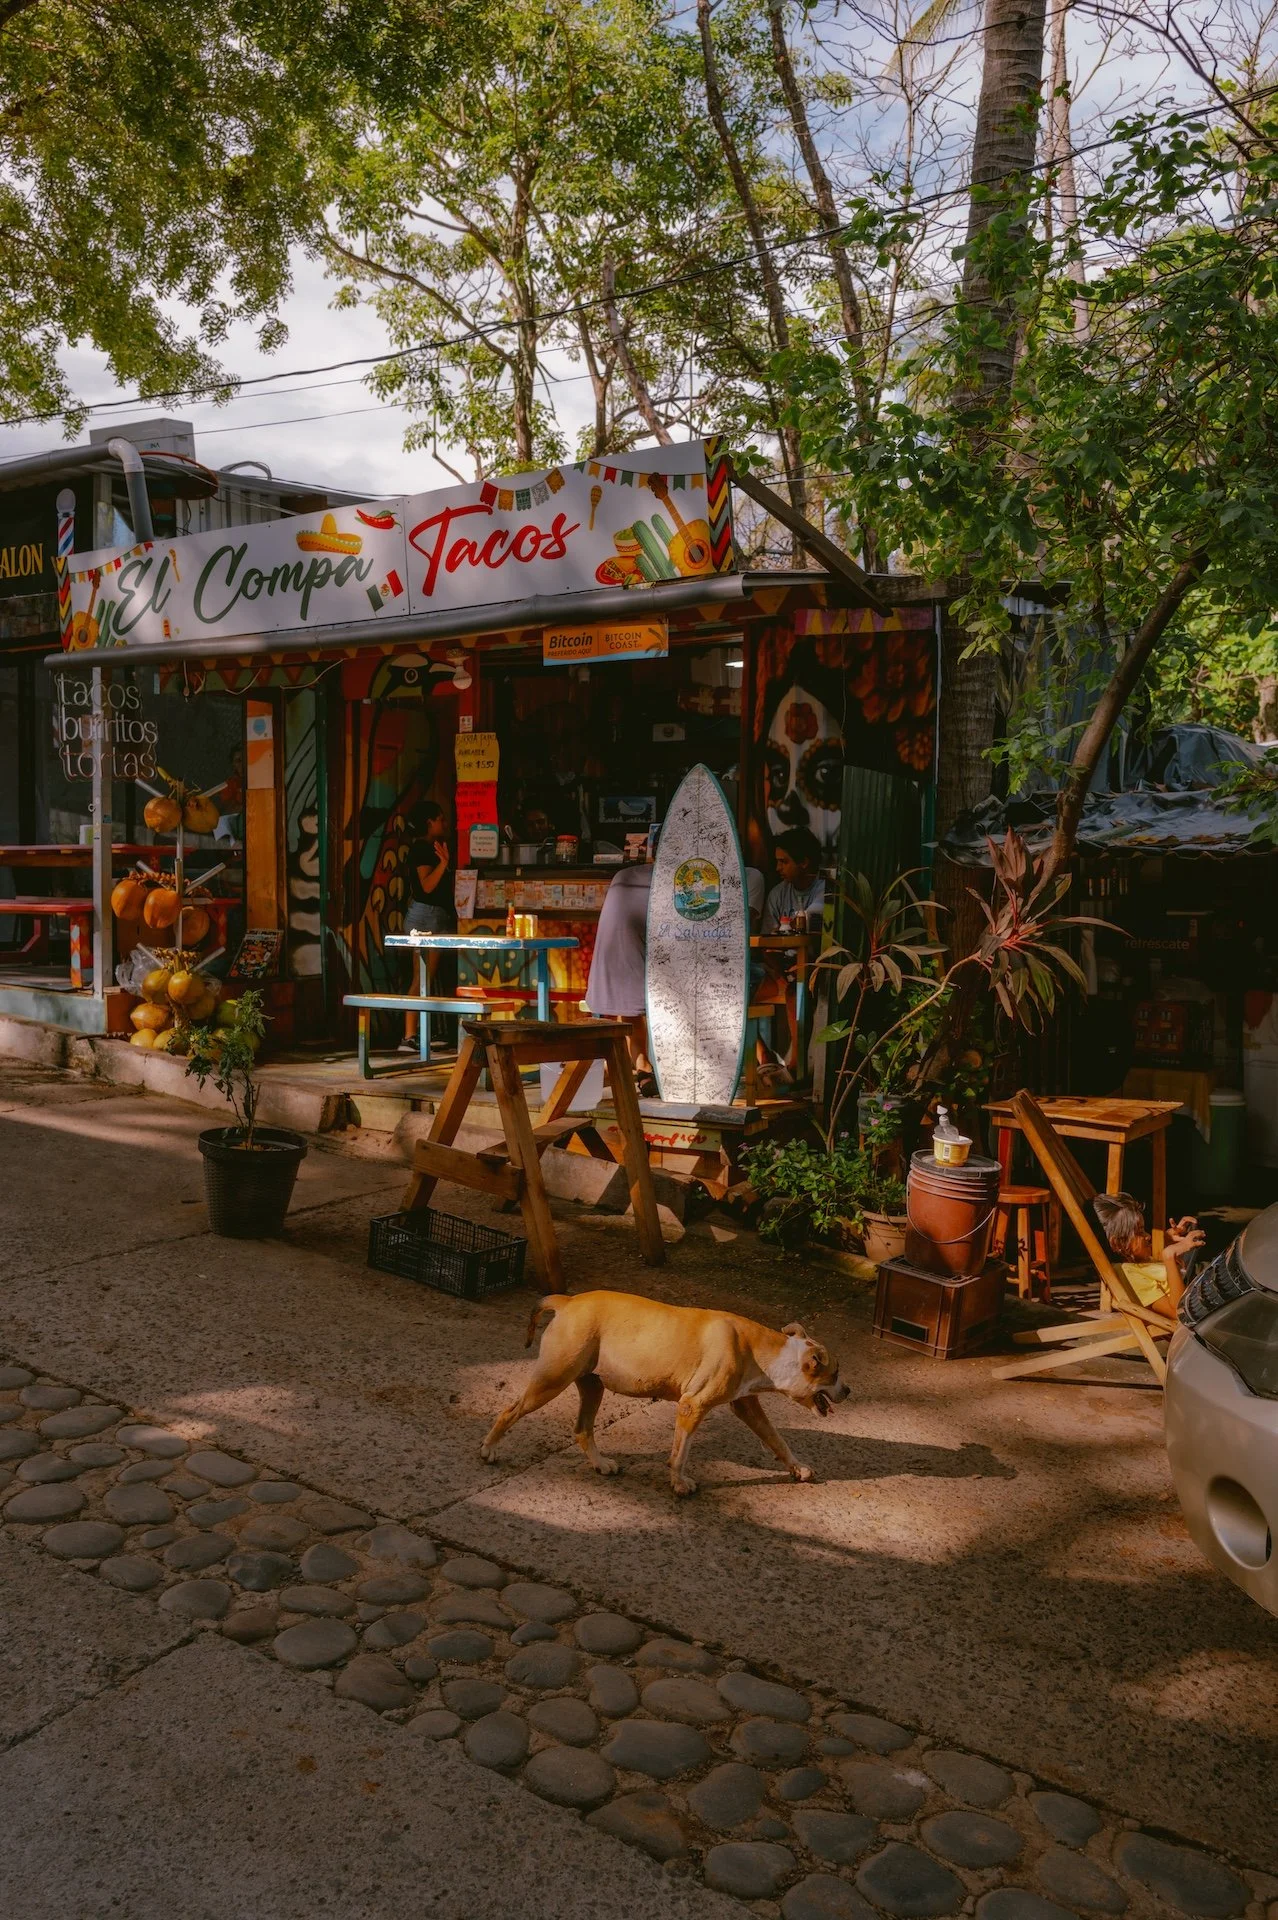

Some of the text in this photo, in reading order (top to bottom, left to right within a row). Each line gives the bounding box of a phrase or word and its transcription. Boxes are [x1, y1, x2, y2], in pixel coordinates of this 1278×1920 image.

[112, 505, 580, 636] El Compa Tacos
[549, 632, 593, 649] Bitcoin
[605, 632, 642, 642] BITCOIN
[609, 641, 638, 650] COAST
[548, 649, 577, 657] PREFERIDO
[58, 673, 140, 709] tacos
[62, 704, 157, 743] burritos
[64, 744, 155, 778] tortas
